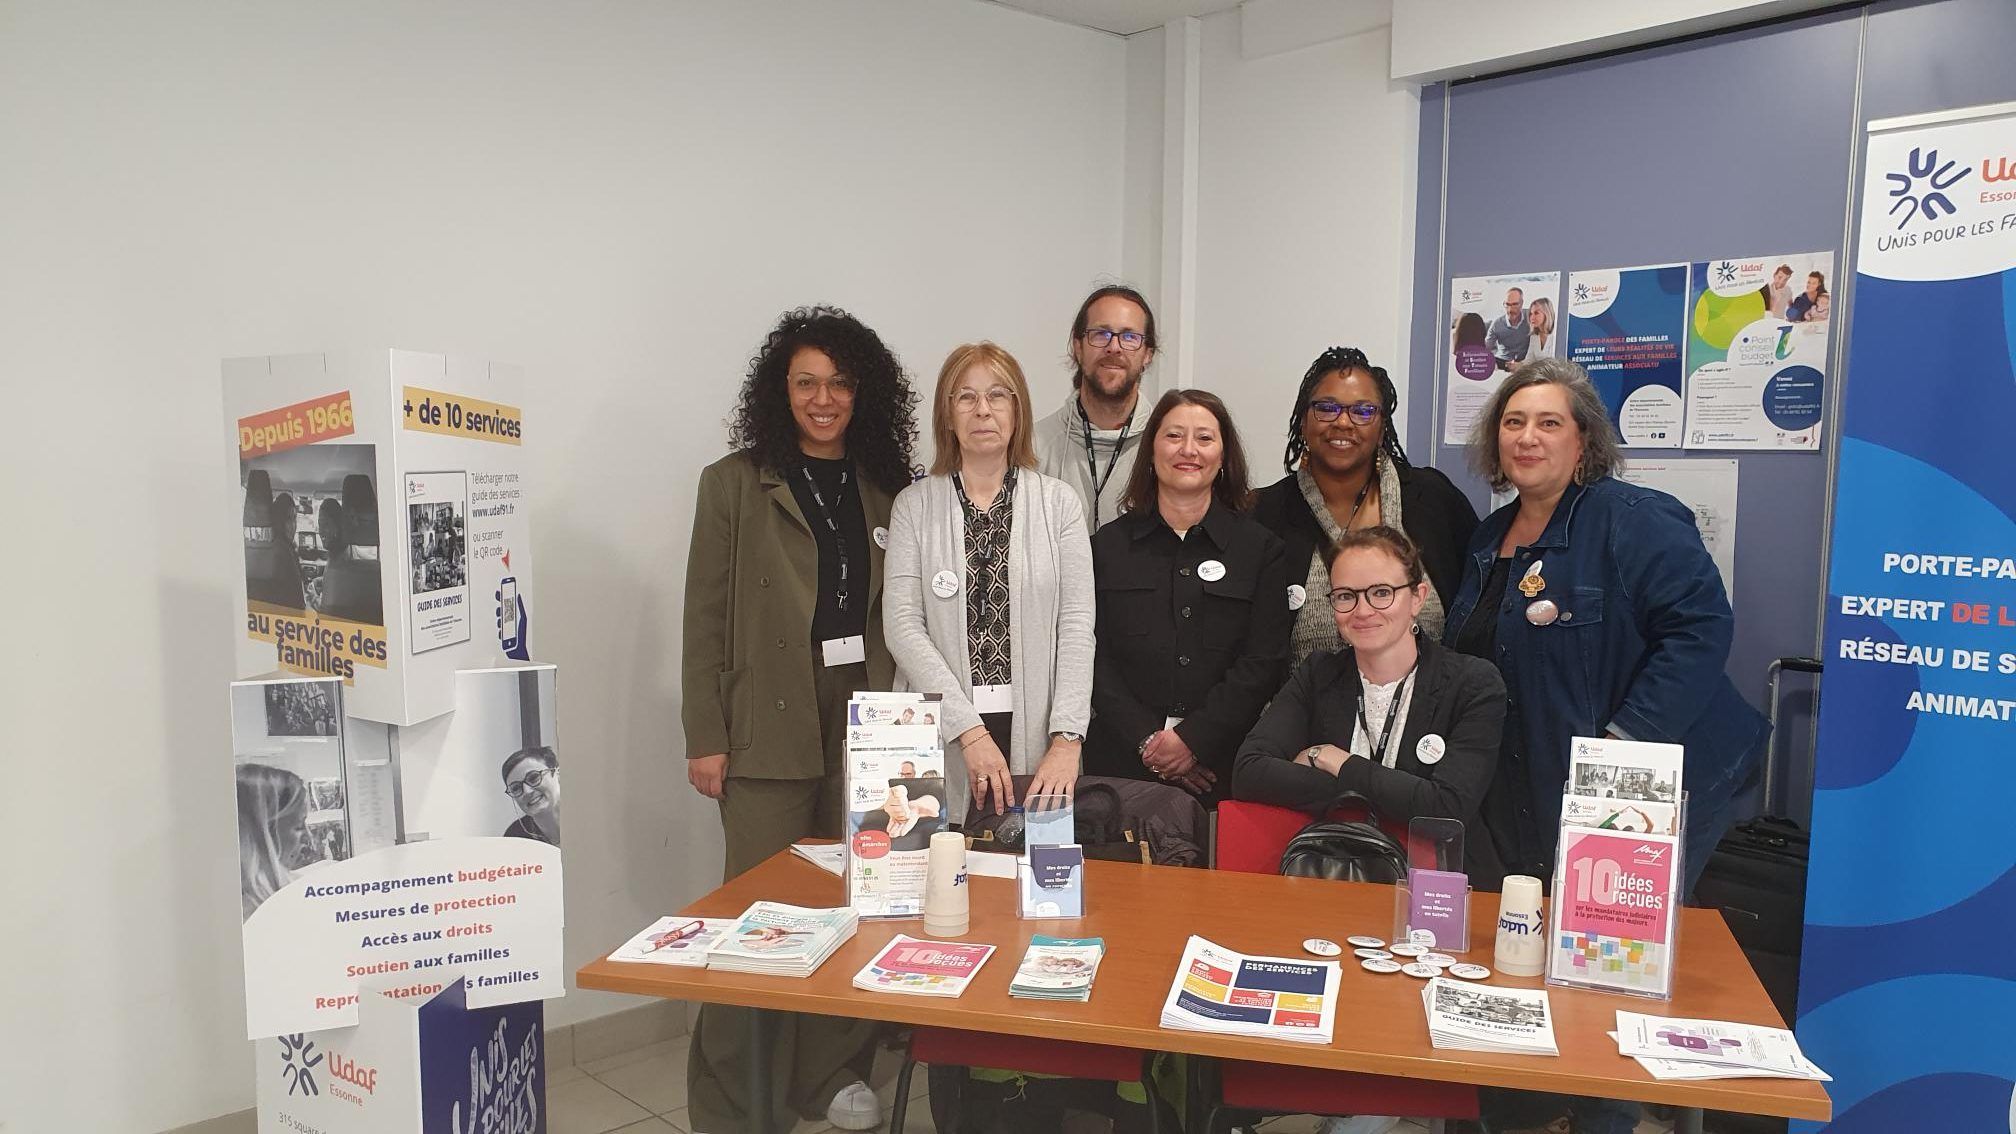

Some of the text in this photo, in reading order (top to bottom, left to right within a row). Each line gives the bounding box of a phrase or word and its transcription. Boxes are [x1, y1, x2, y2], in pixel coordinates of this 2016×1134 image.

[1923, 225, 1966, 245] POUR
[1971, 220, 1994, 236] LES
[1740, 263, 1764, 273] Udaf
[1638, 335, 1669, 343] FAMILLES
[1739, 343, 1775, 353] conseil
[1751, 335, 1775, 344] Point
[1572, 355, 1594, 363] RÉSEAU
[1741, 351, 1775, 363] budget
[1587, 363, 1624, 371] ANIMATEUR
[240, 399, 353, 452] Depuis 1966
[419, 397, 441, 426] de
[445, 402, 462, 429] 10
[466, 409, 521, 439] services
[471, 472, 519, 486] Télécharger notre
[472, 489, 520, 504] guide des services
[472, 503, 515, 518] www.udaf91.fr
[472, 530, 504, 543] ou scanner
[474, 544, 503, 560] le QR code
[417, 599, 433, 612] GUIDE
[1841, 595, 1946, 622] EXPERT
[1951, 602, 1990, 625] DE
[247, 613, 387, 661] au service des
[276, 637, 354, 679] familles
[1839, 637, 1944, 667] RÉSEAU
[1952, 649, 1990, 673] DE
[304, 862, 543, 898] Accompagnement budgétaire
[1572, 856, 1654, 906] 10 idées
[335, 892, 517, 923] Mesures de protection
[1612, 889, 1663, 910] reçues
[1505, 911, 1529, 920] Essonne
[361, 921, 493, 948] Accès aux droits
[346, 946, 510, 978] Soutien aux familles
[895, 947, 969, 965] 10 idées
[478, 970, 540, 989] familles
[1442, 1014, 1472, 1024] GUIDE
[328, 1050, 377, 1096] Udaf
[329, 1083, 364, 1107] Essonne
[279, 1111, 293, 1127] 315
